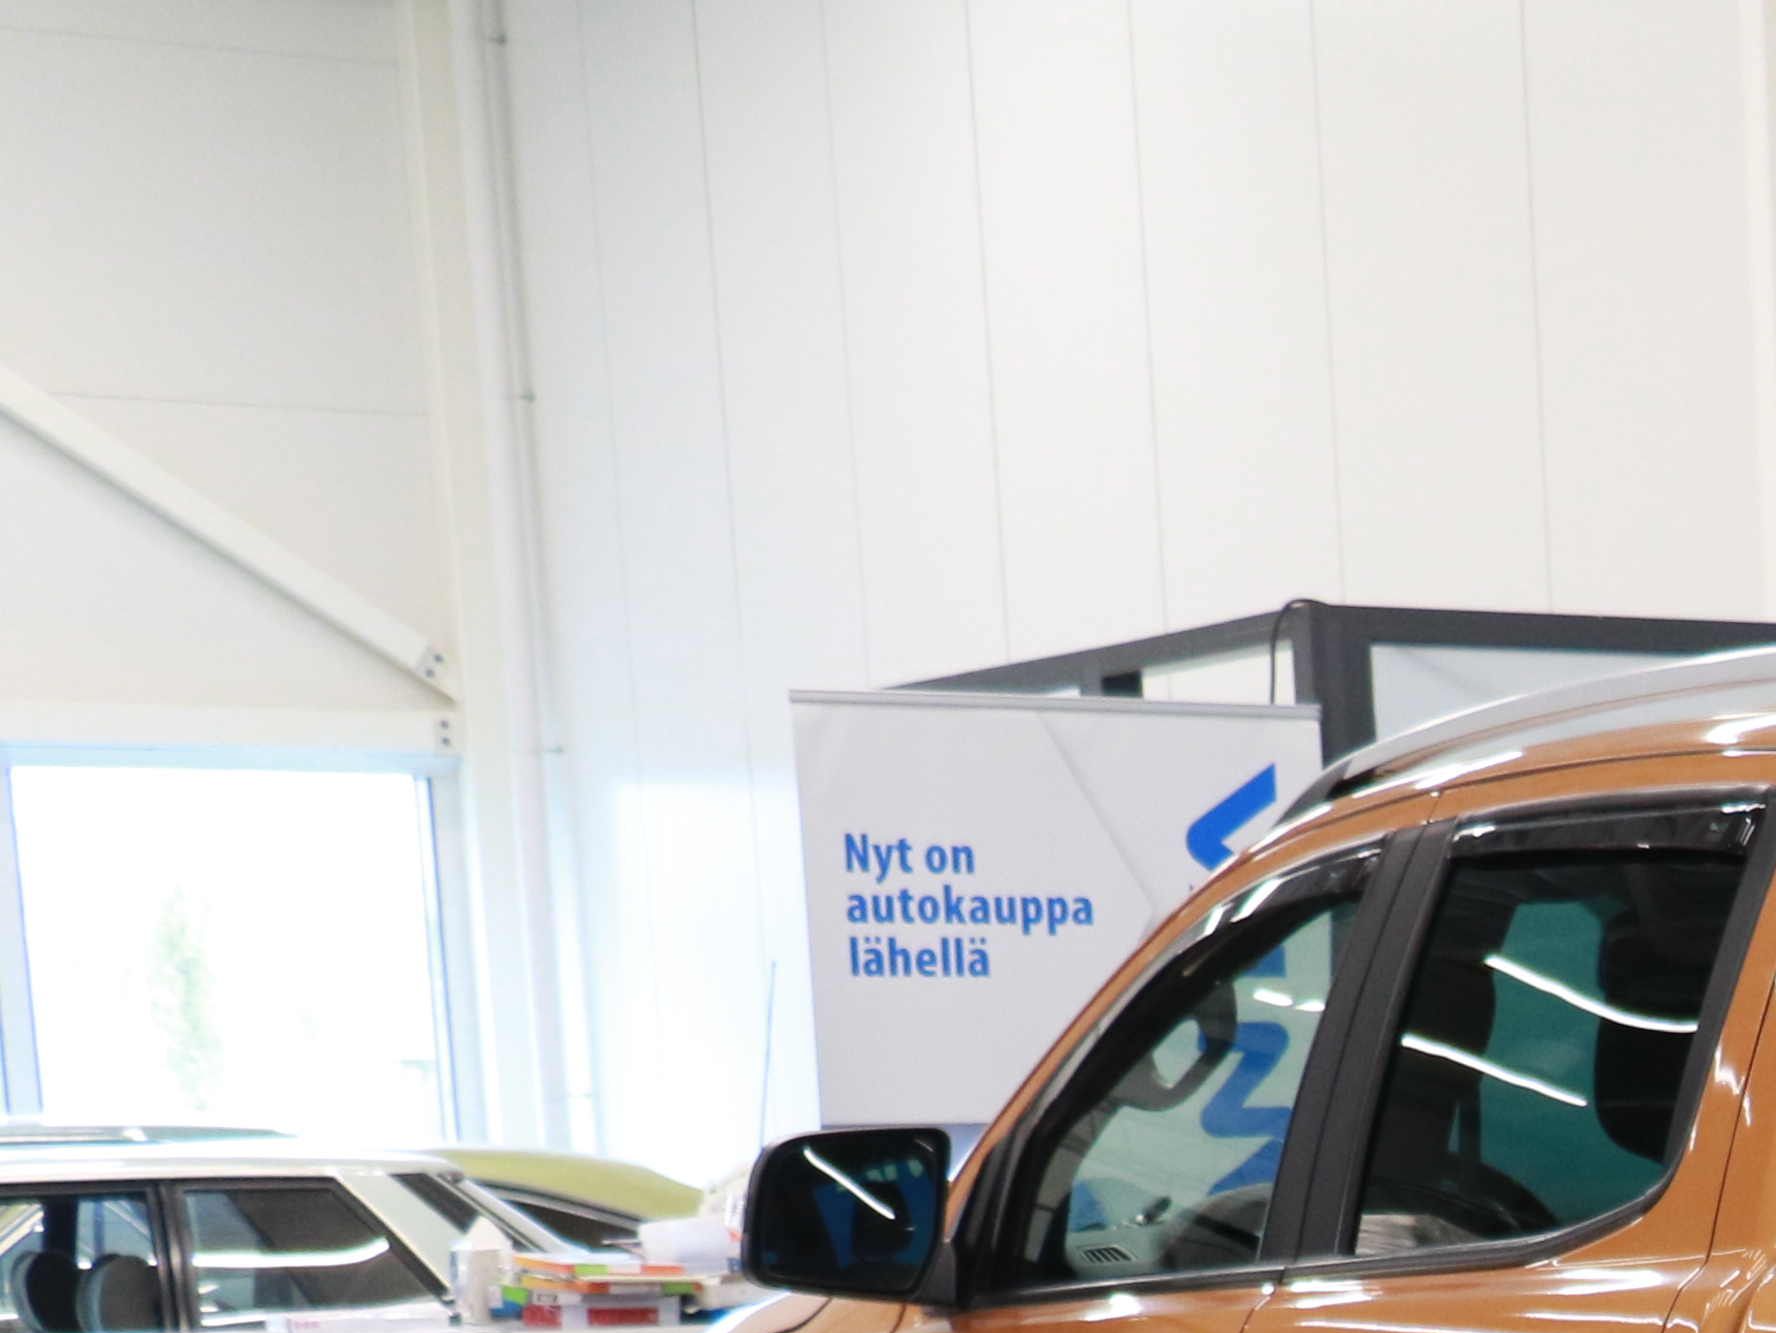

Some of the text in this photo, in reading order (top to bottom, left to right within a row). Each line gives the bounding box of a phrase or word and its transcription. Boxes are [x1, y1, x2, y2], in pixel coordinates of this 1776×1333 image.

[844, 832, 975, 884] Nyt on
[846, 884, 1094, 936] autokauppa
[849, 936, 991, 977] lähellä
